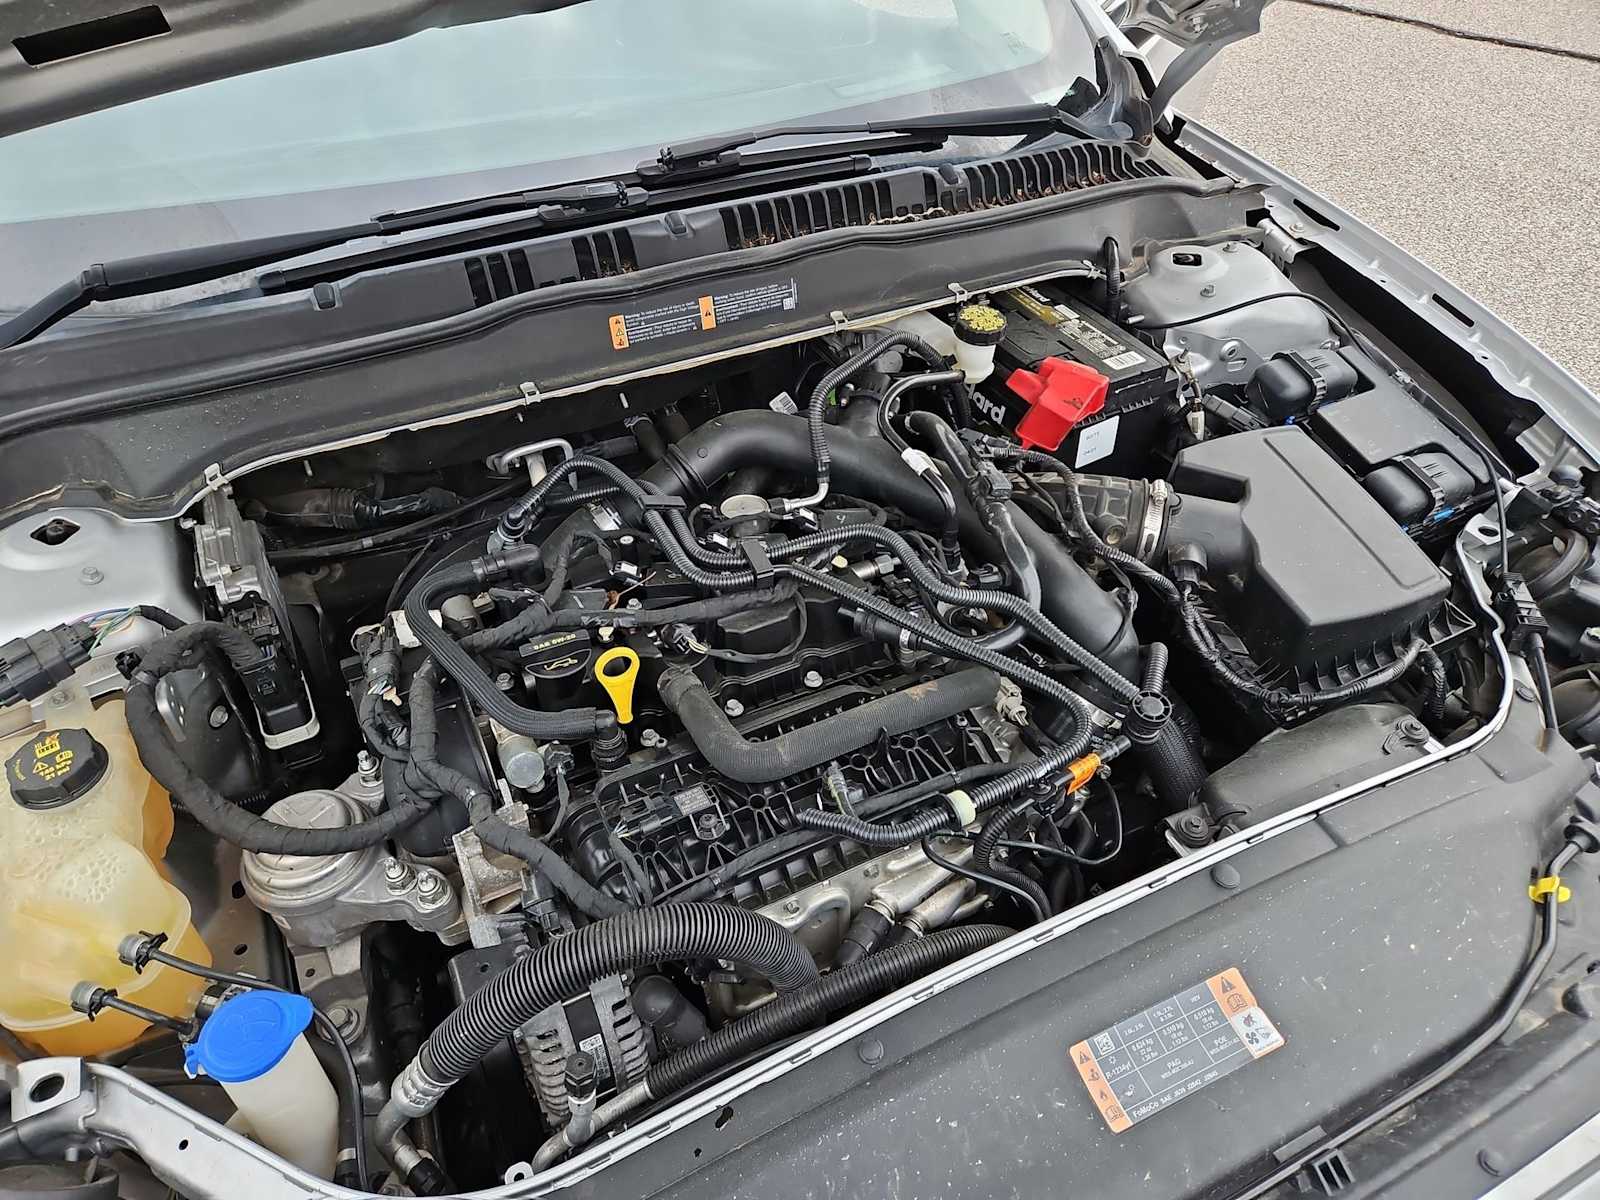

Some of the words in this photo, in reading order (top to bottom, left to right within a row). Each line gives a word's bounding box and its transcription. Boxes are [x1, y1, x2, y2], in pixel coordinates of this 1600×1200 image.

[1106, 1060, 1132, 1080] R-1234yf
[1166, 1058, 1182, 1069] PAG
[1132, 1101, 1159, 1118] FoMoCo
[1160, 1093, 1172, 1104] SAE
